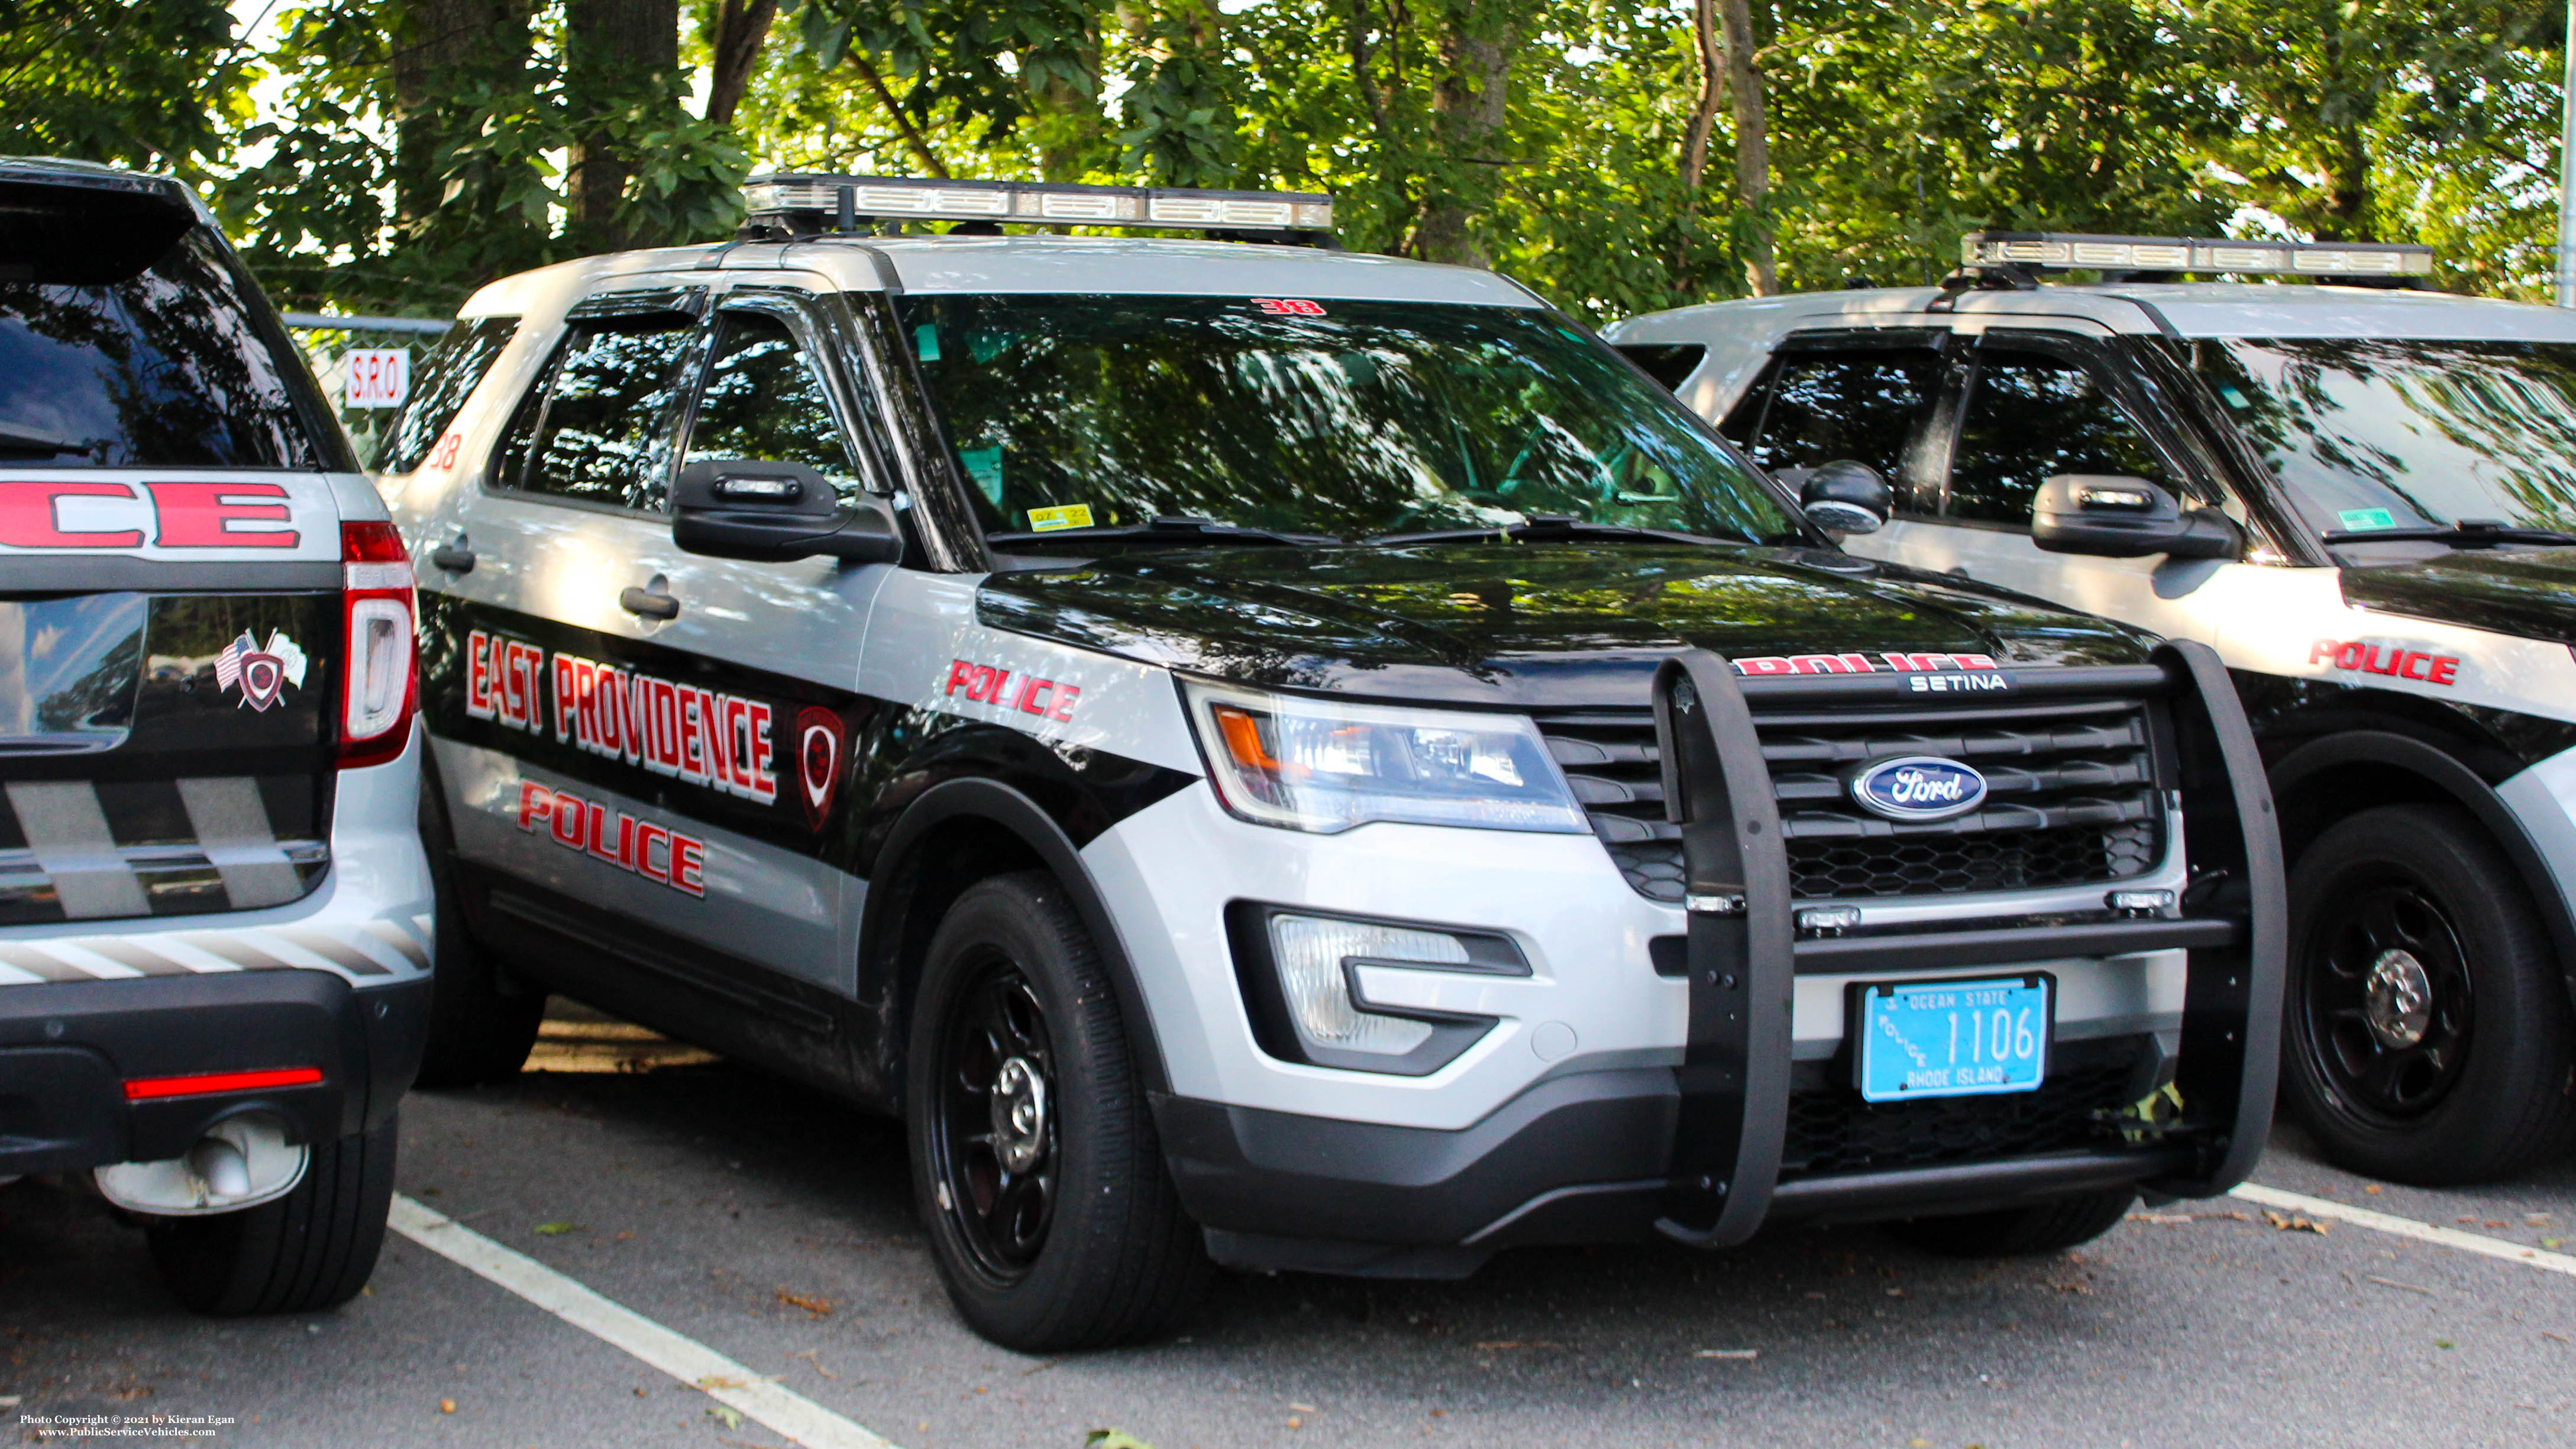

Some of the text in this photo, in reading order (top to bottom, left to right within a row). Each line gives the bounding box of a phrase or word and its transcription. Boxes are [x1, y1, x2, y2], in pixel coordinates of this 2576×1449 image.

[1250, 298, 1327, 315] 38
[429, 432, 461, 471] 38
[1909, 674, 2008, 692] SETINA
[2308, 638, 2459, 686] POLICE
[945, 659, 1080, 723] POLICE
[466, 630, 777, 806] EAST PROVIDENCE
[1892, 771, 1963, 803] Ford
[516, 776, 706, 898] POLICE
[1909, 990, 2007, 1010] OCEAN STATE
[1878, 1014, 1927, 1068] POLICE
[1948, 1007, 2034, 1065] 1106
[1906, 1066, 2004, 1088] RHODE ISLAND
